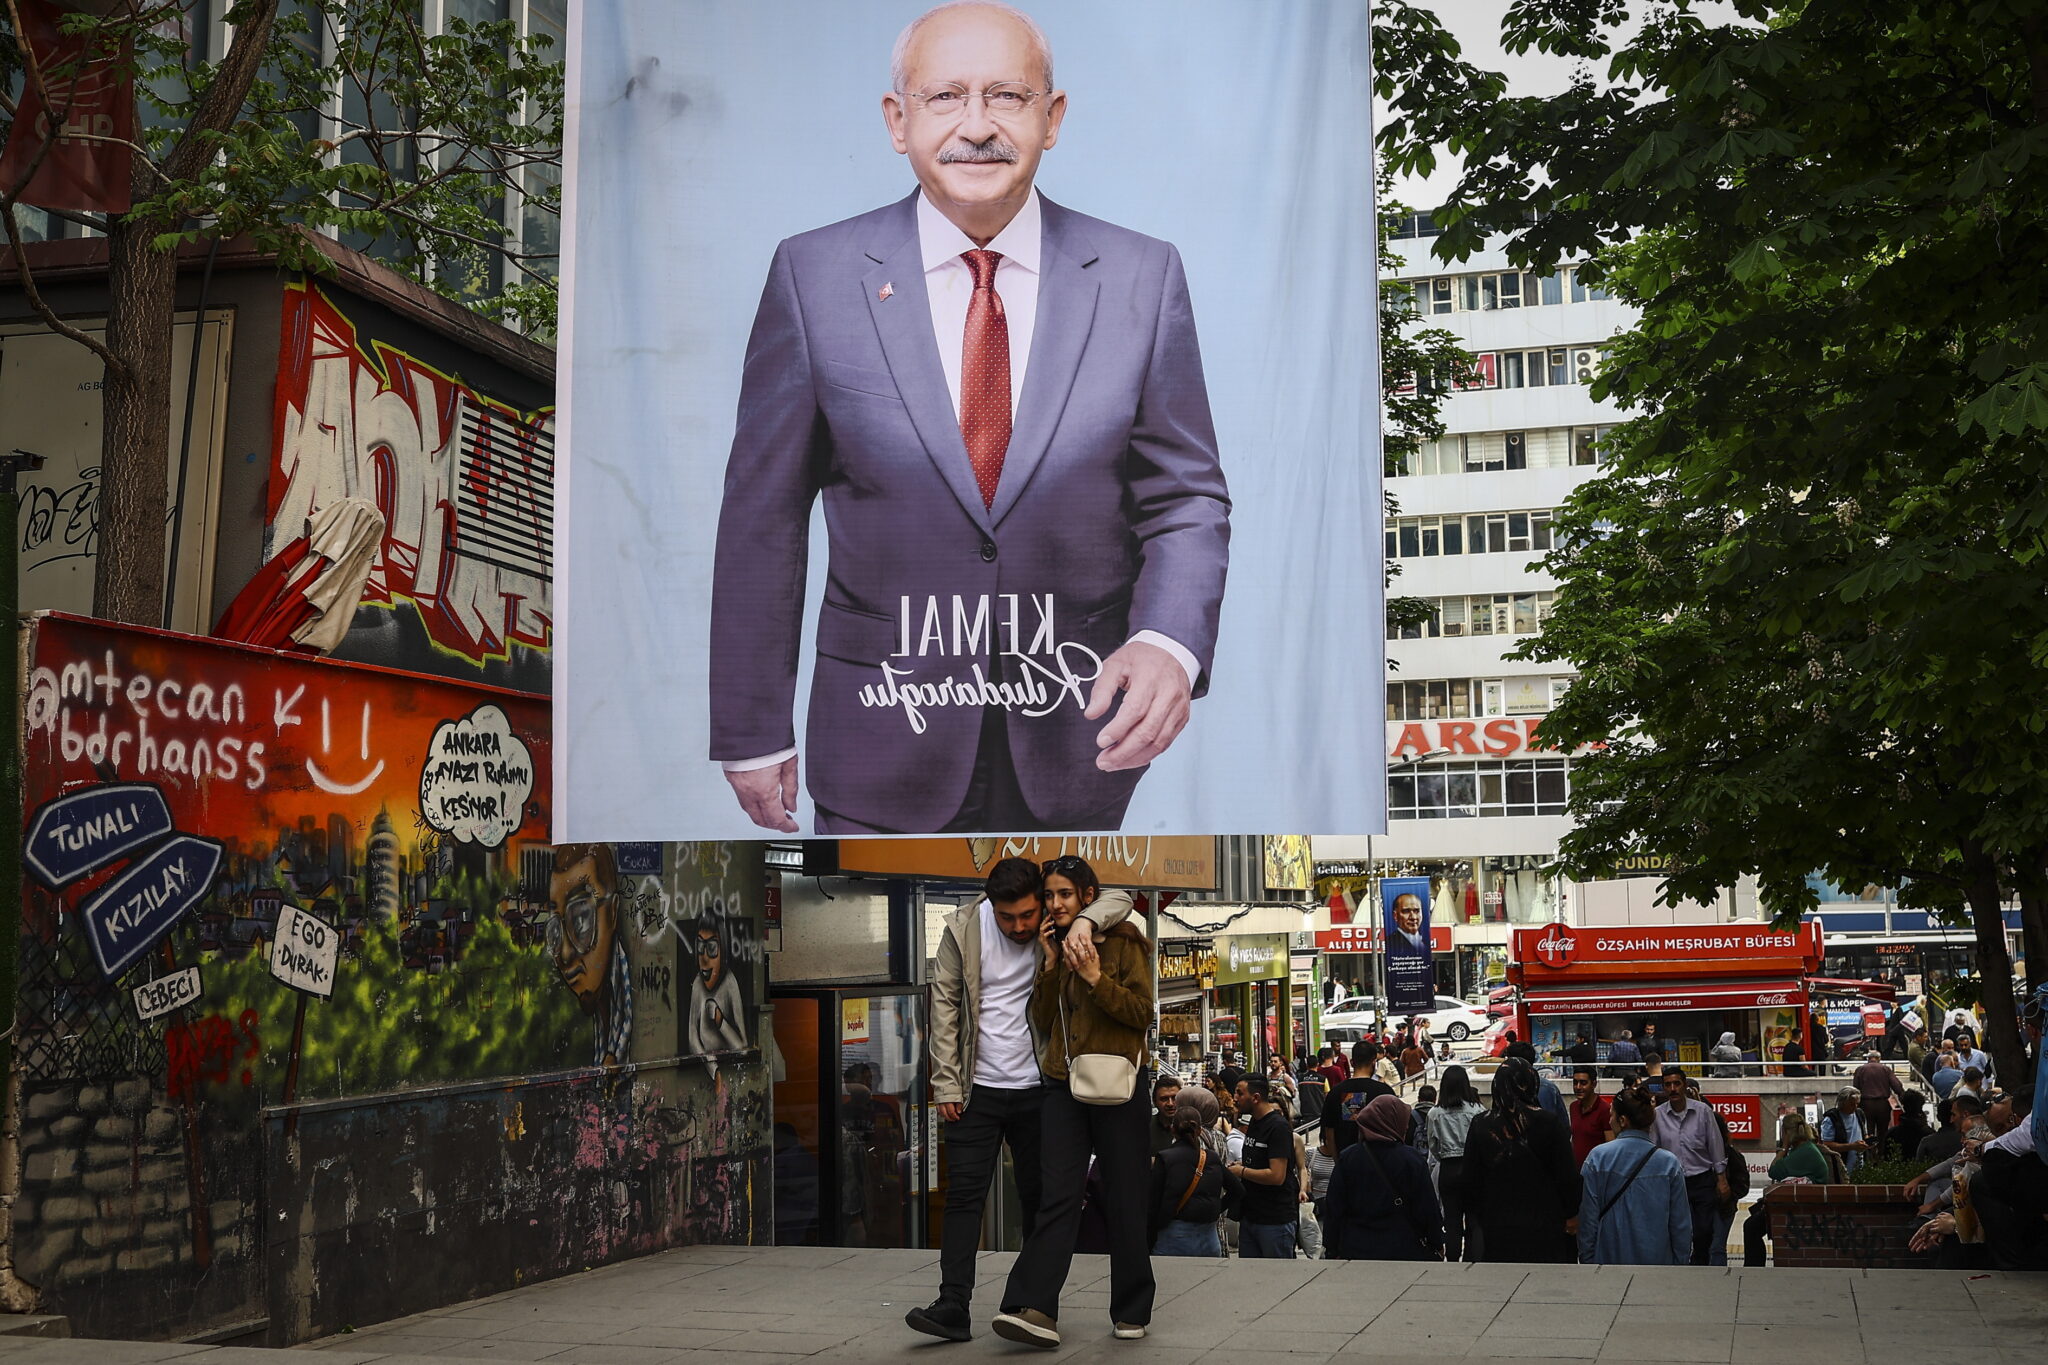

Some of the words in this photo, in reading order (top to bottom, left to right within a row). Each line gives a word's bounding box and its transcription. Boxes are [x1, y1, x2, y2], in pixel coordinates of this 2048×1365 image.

[443, 732, 501, 758] ANKARA
[1317, 865, 1359, 875] Gelinlik
[105, 857, 186, 942] KIZILAY
[291, 912, 325, 949] EGO
[1596, 937, 1660, 953] ÖZŞAHİN
[1664, 937, 1740, 952] MEŞRUBAT
[1745, 933, 1796, 949] BÜFESİ
[1571, 1001, 1605, 1010] MEŞRUBAT
